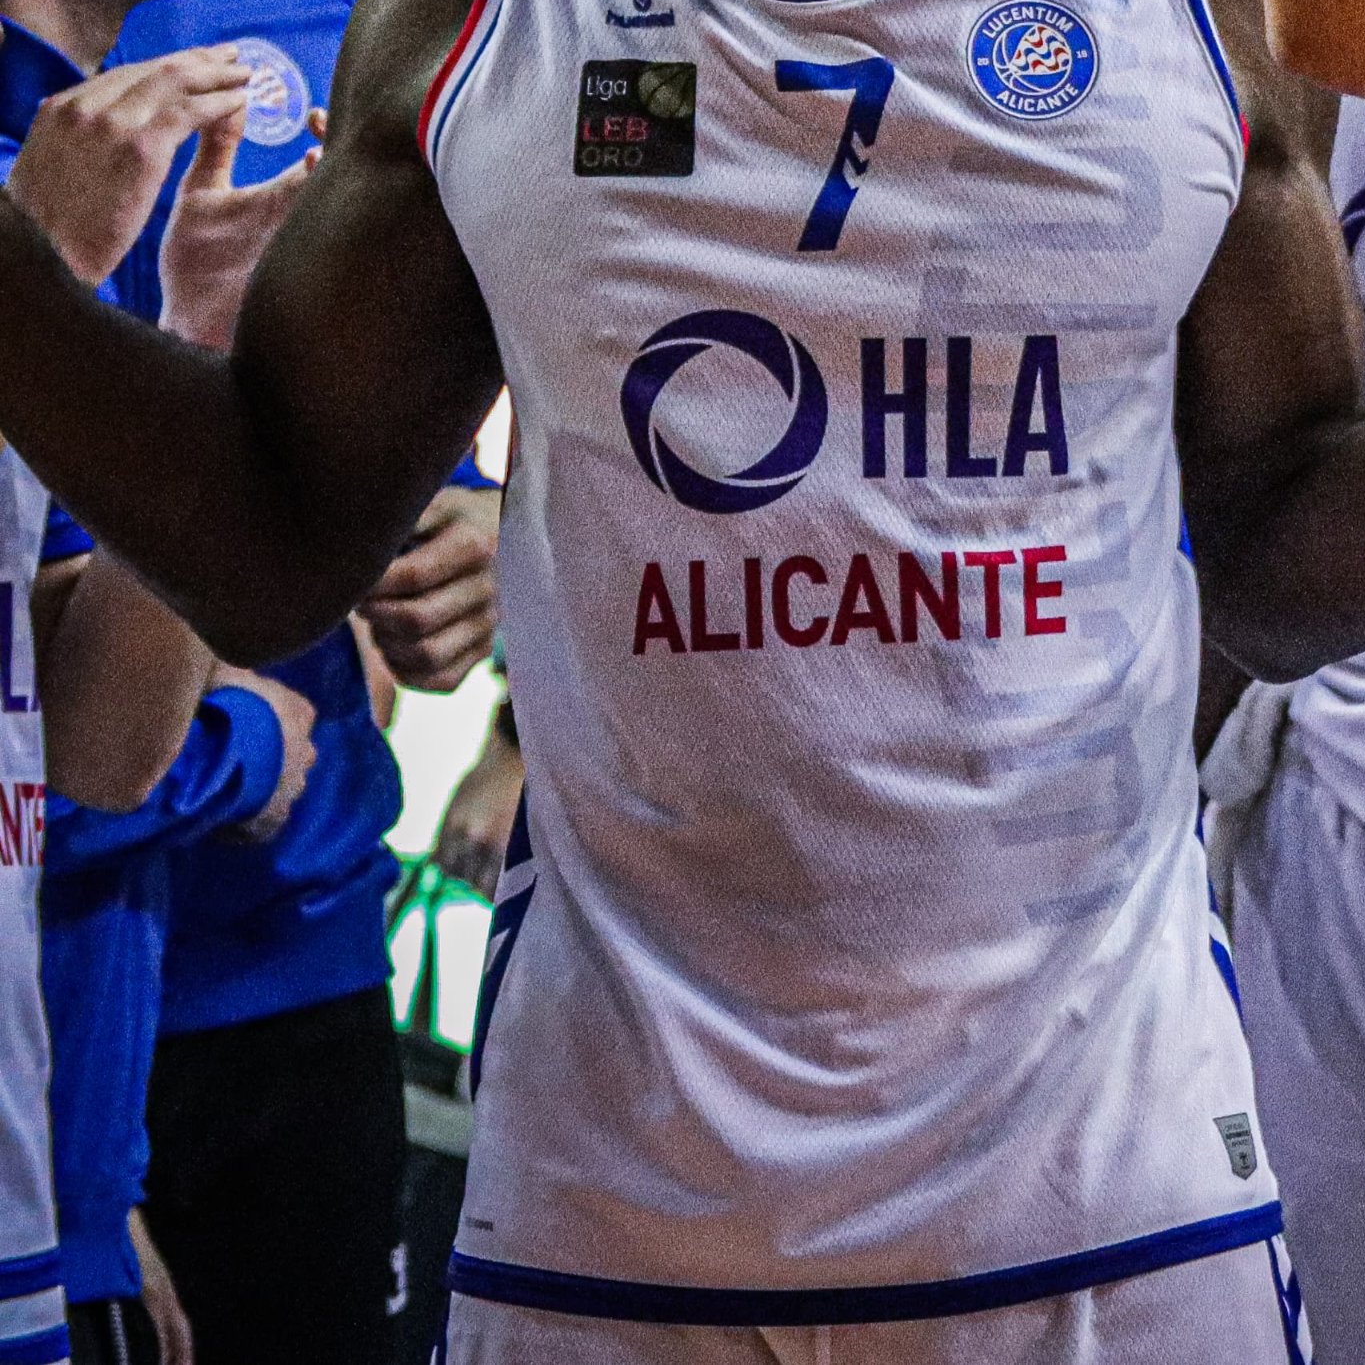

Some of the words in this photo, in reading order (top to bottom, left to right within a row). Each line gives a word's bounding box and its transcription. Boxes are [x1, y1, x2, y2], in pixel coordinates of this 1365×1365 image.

[982, 6, 1075, 39] LUCENTUM
[586, 76, 628, 101] Liga
[996, 83, 1079, 112] ALICANTE
[582, 116, 649, 141] LEB
[582, 147, 644, 168] ORO
[775, 56, 896, 252] 7
[862, 334, 1069, 479] HLA
[632, 544, 1068, 656] ALICANTE
